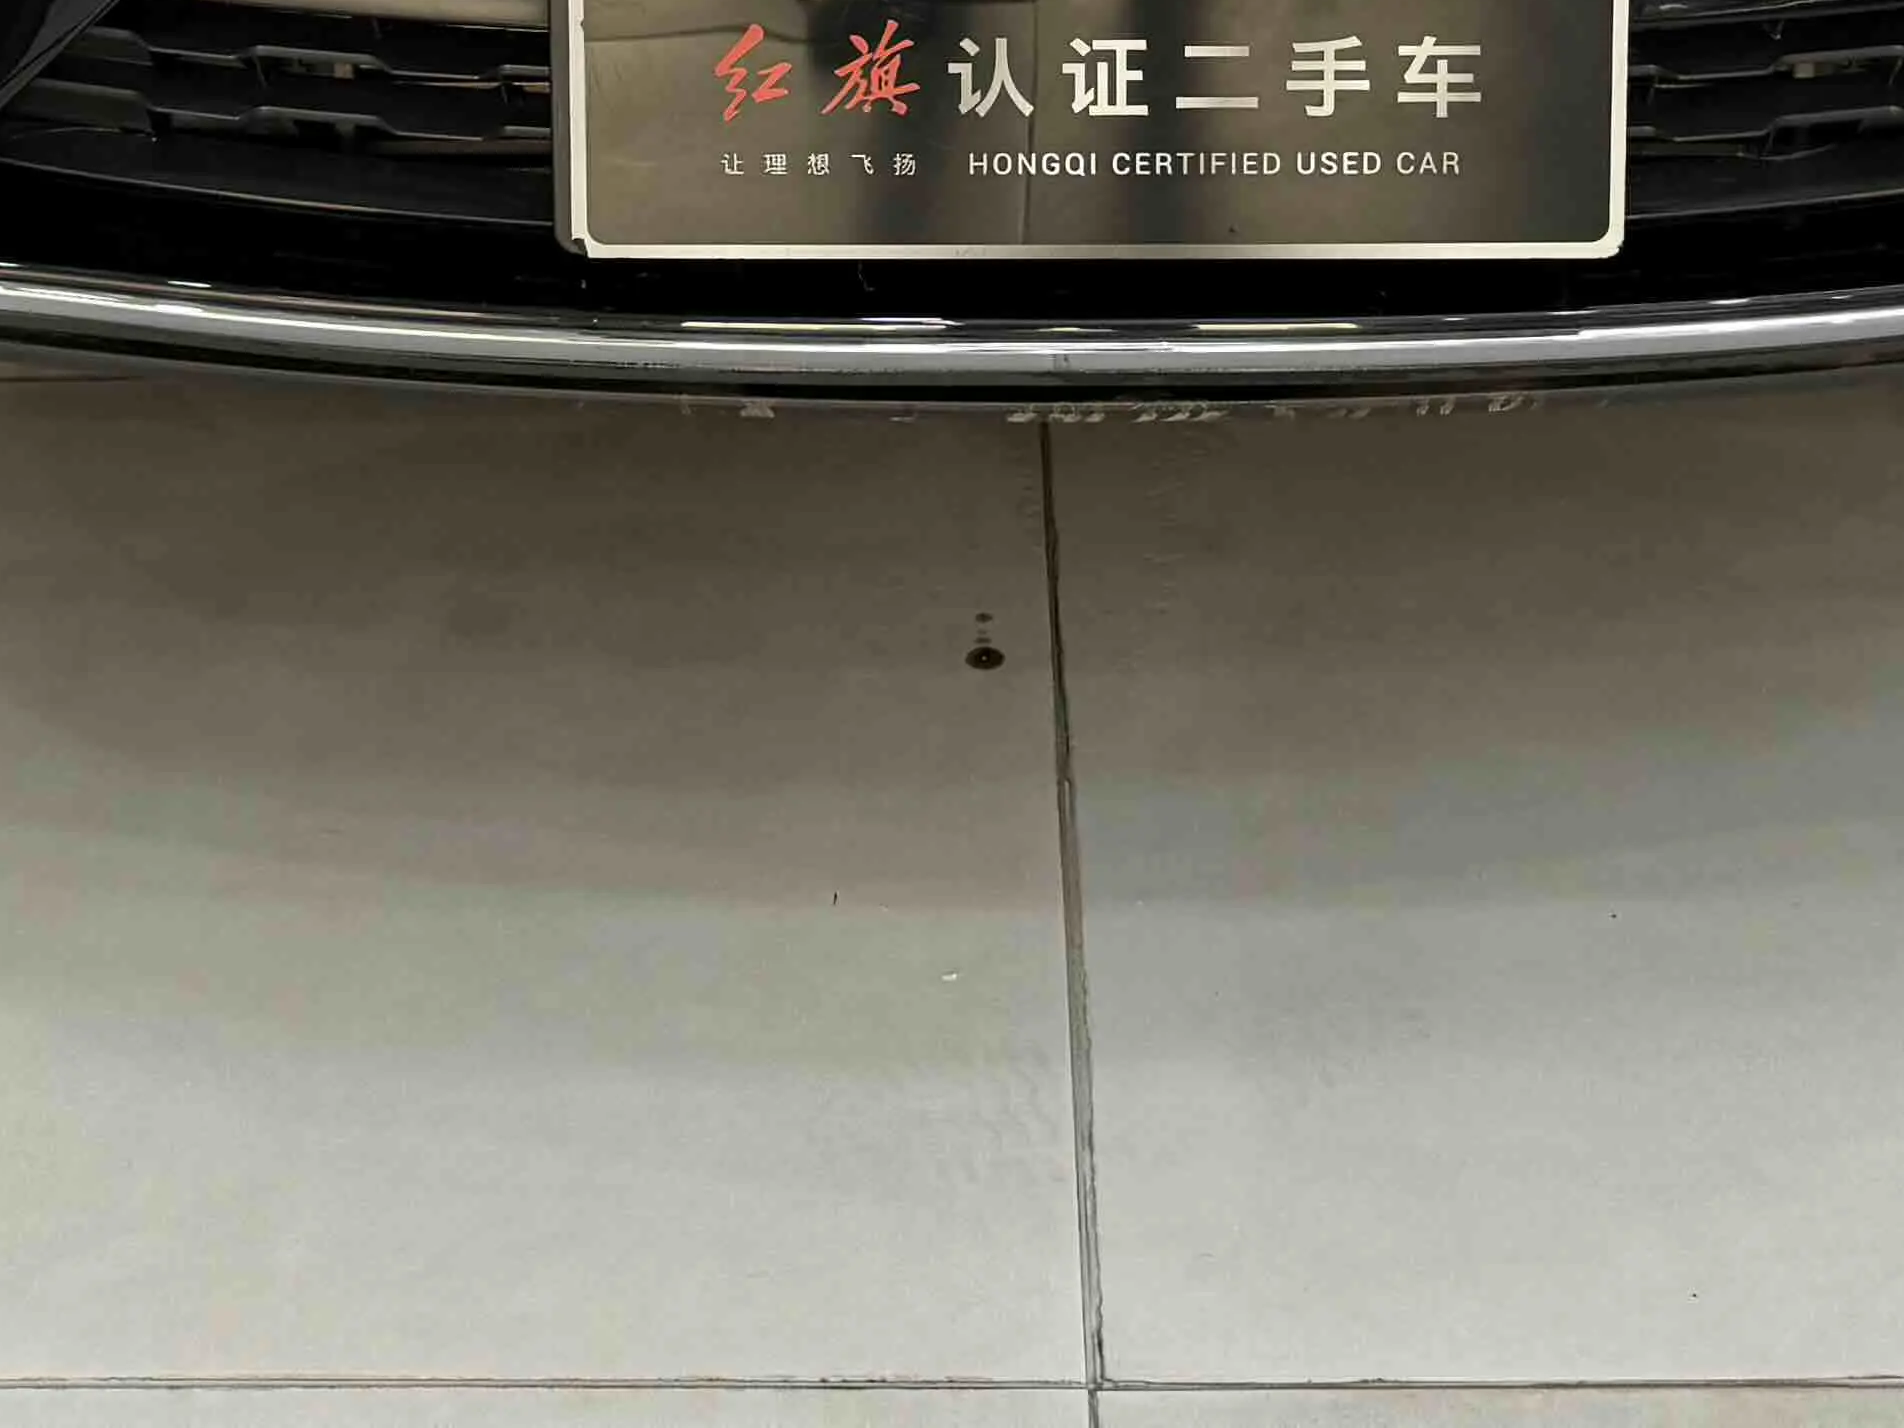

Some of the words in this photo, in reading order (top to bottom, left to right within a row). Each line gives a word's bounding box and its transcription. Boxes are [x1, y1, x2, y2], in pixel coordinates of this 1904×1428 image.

[721, 152, 917, 177] 让理想飞扬
[969, 151, 1097, 178] HONGQI
[1112, 151, 1281, 176] CERTIFIED
[1297, 151, 1382, 176] USED
[1396, 151, 1461, 176] CAR
